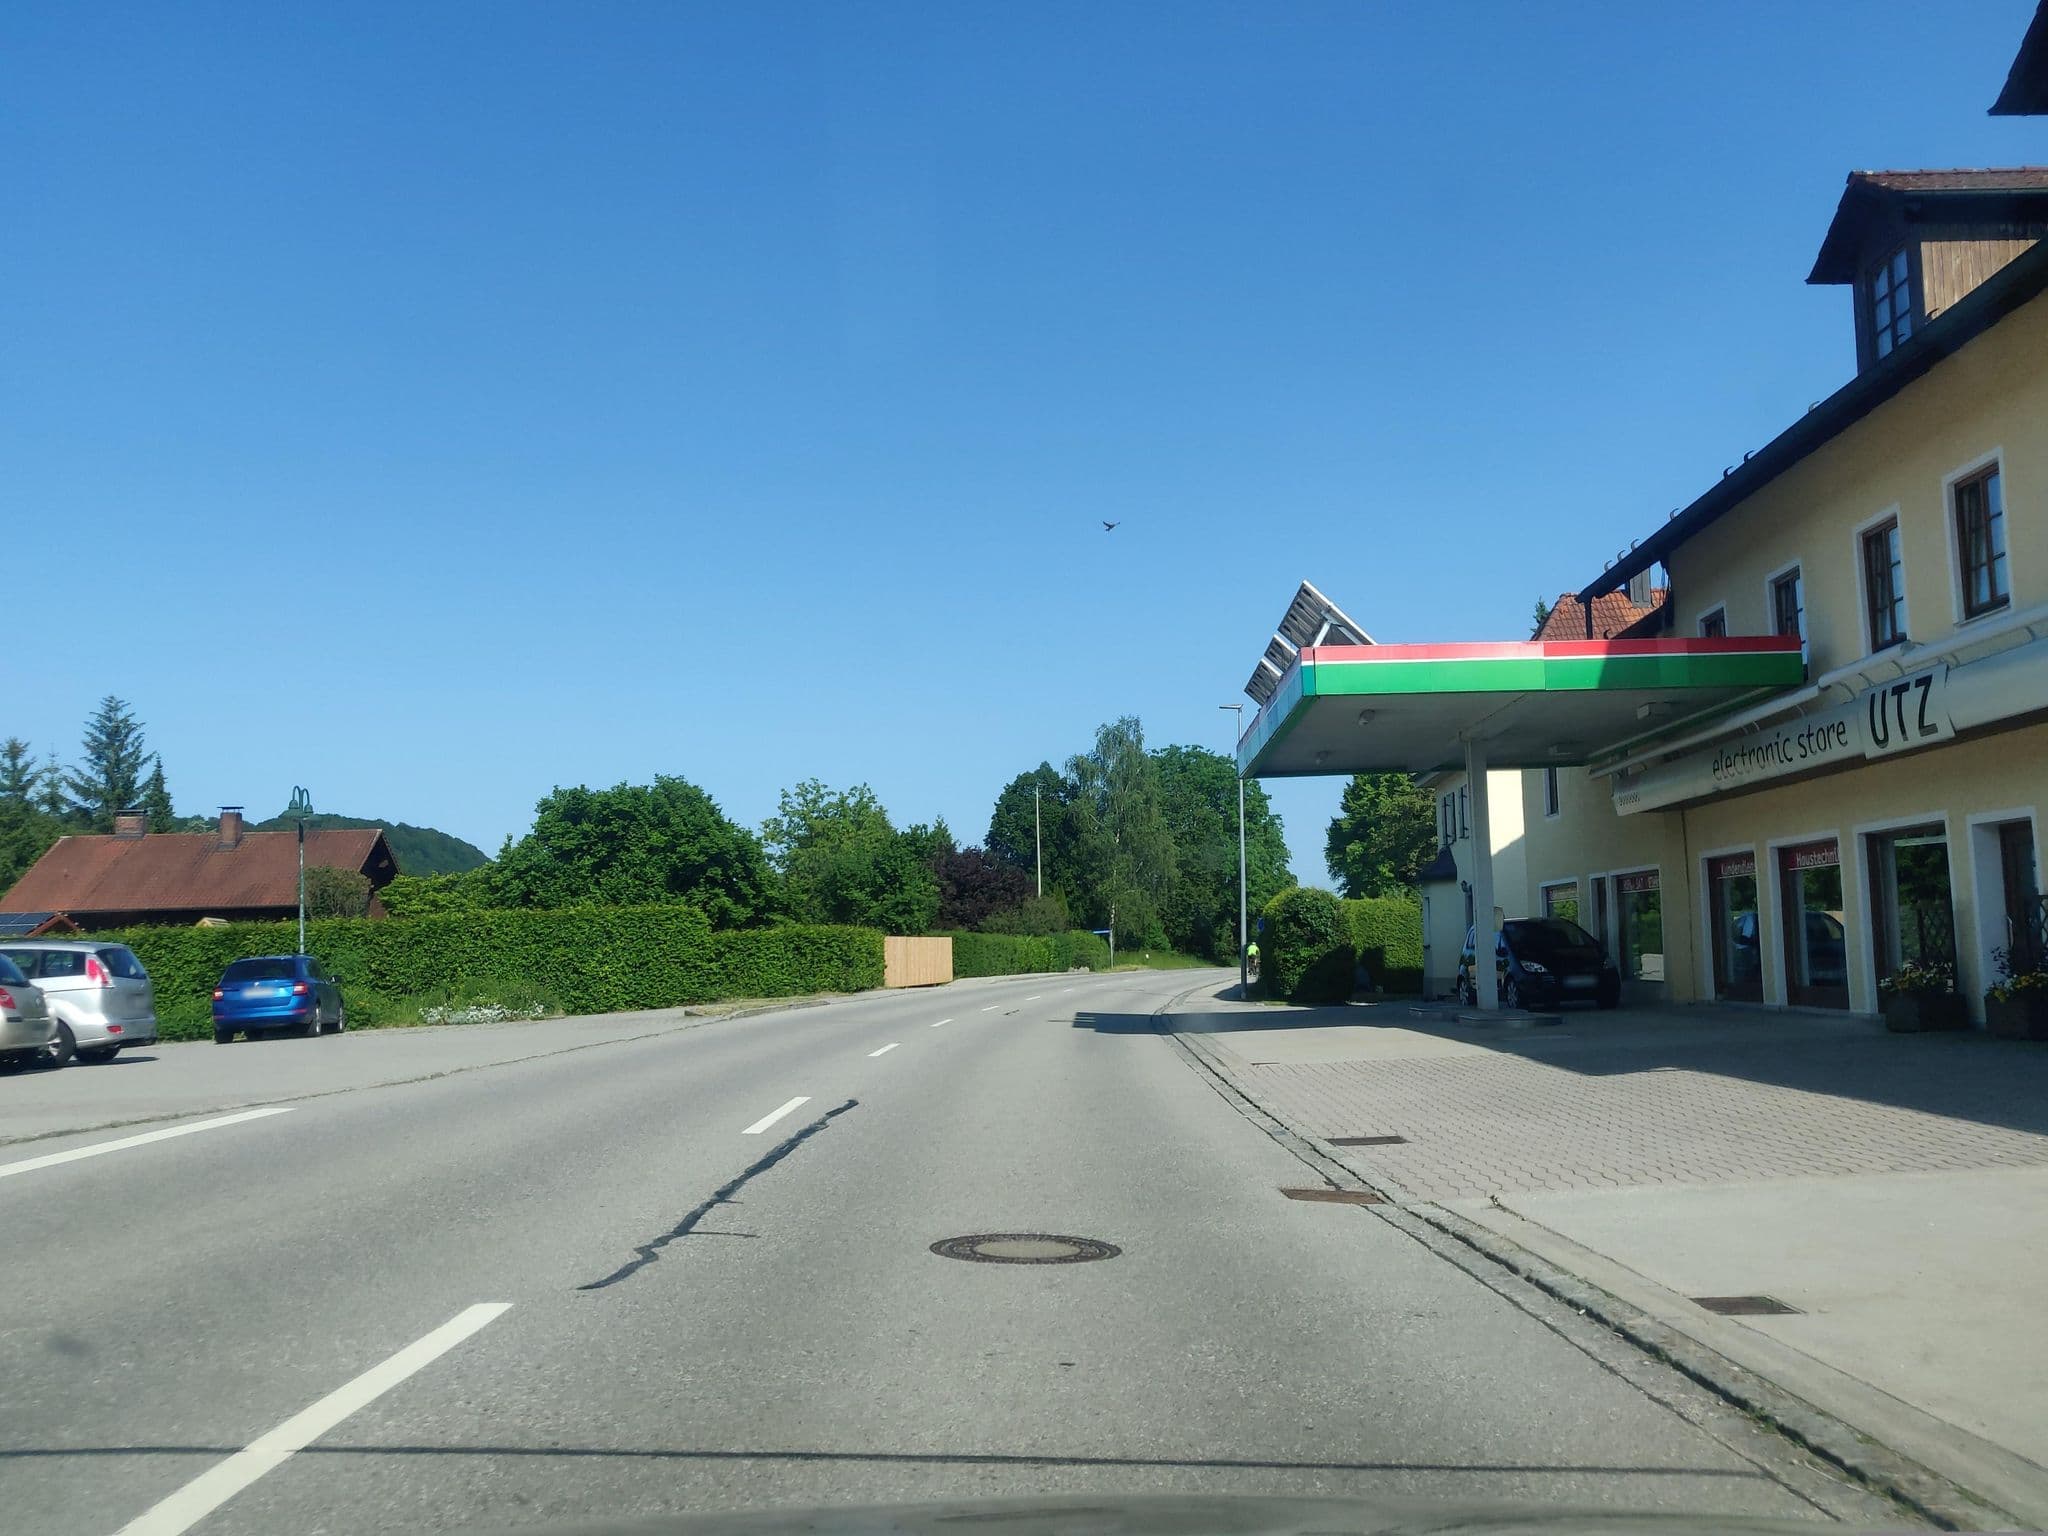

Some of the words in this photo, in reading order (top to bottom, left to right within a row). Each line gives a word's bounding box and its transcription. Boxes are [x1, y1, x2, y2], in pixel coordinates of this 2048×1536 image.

[1712, 732, 1793, 781] electronic
[1797, 721, 1848, 759] store
[1869, 673, 1939, 748] UTZ
